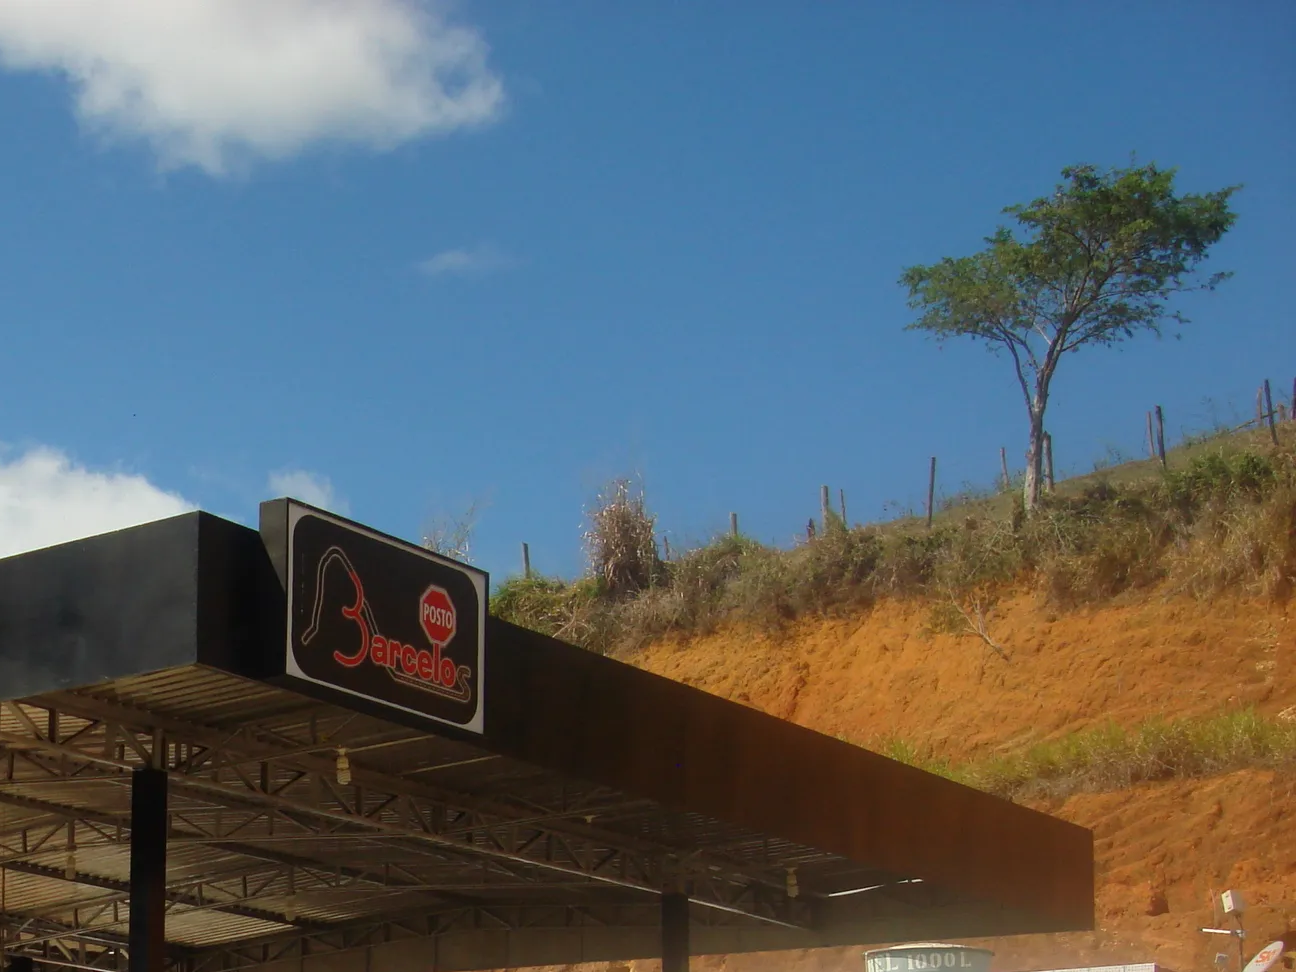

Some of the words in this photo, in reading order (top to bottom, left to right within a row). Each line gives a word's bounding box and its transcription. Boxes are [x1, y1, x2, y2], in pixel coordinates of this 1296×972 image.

[423, 607, 453, 629] POSTO
[326, 564, 472, 702] Barcelos
[907, 952, 956, 971] 1000
[960, 951, 972, 968] L
